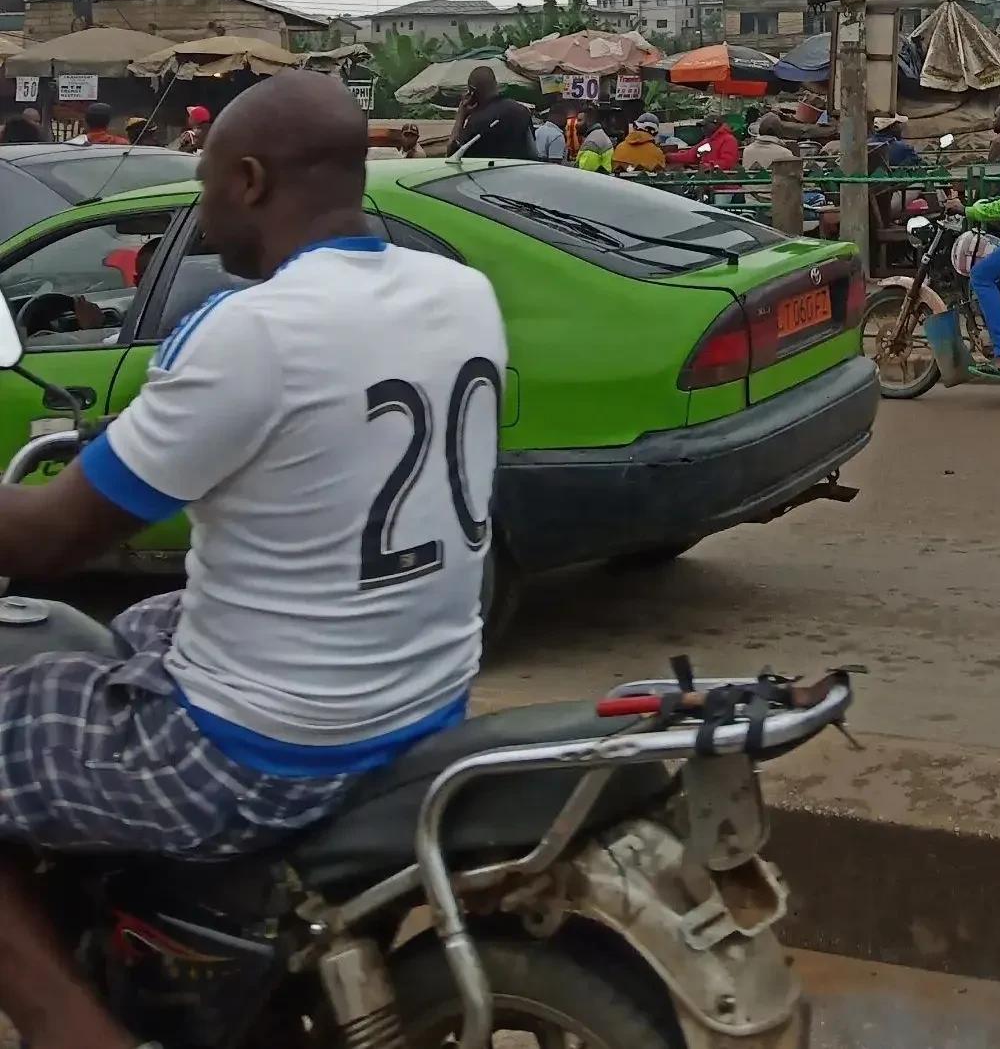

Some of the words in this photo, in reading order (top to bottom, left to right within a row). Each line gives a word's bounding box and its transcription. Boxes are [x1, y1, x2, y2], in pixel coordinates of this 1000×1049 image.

[23, 81, 37, 98] 50
[571, 77, 599, 99] 50
[359, 356, 501, 592] 20
